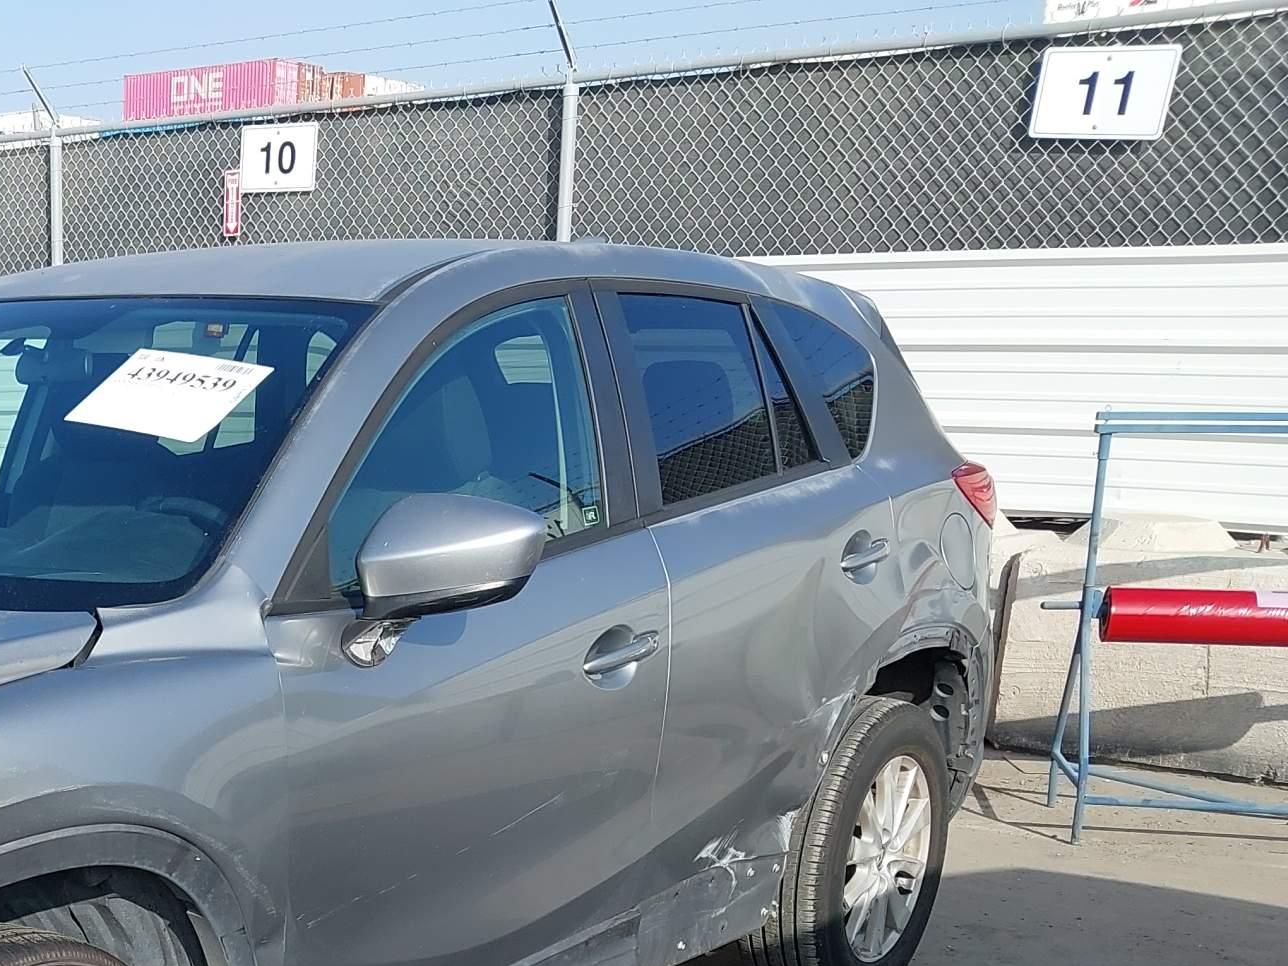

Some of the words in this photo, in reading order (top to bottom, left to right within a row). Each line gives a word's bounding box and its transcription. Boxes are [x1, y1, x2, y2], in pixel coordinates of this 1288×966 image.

[170, 71, 224, 104] ONE
[1078, 70, 1135, 115] 11
[260, 141, 296, 174] 10
[127, 366, 237, 392] 43949539
